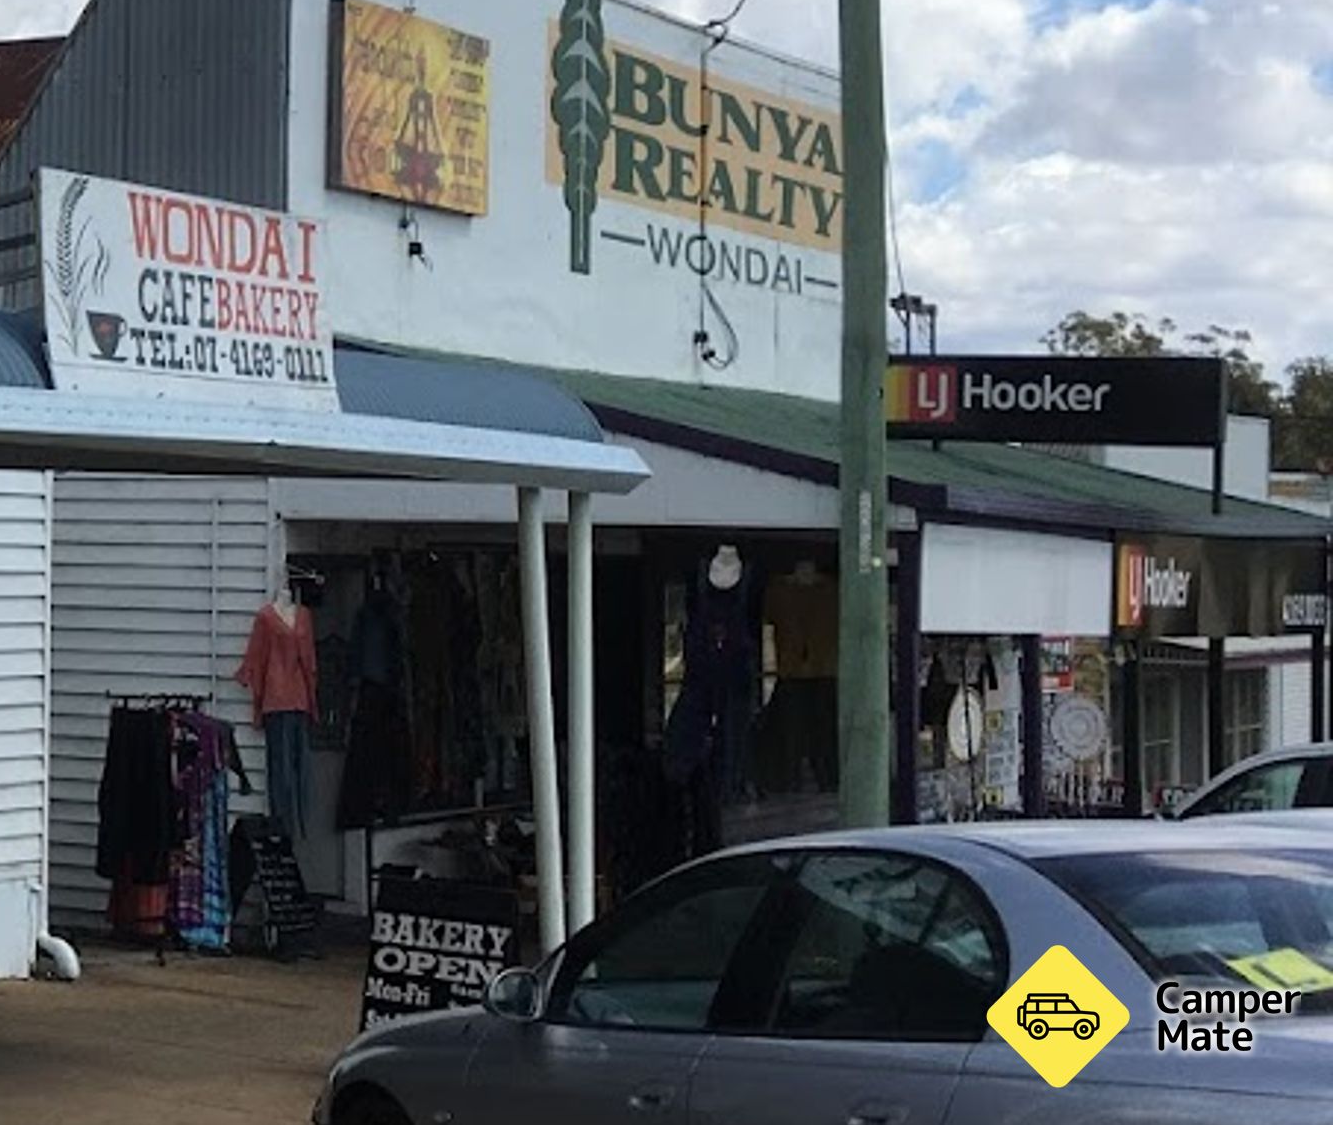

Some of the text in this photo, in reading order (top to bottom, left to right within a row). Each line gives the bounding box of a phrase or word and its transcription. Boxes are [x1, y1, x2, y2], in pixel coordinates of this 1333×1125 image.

[609, 49, 845, 176] BUNYA
[609, 124, 845, 238] REALTY
[127, 191, 317, 284] WONDAI
[646, 223, 802, 295] WONDAI
[917, 372, 1111, 418] LJ Hooker
[1144, 556, 1192, 609] Hooker
[370, 911, 513, 958] BAKERY
[373, 946, 505, 985] OPEN
